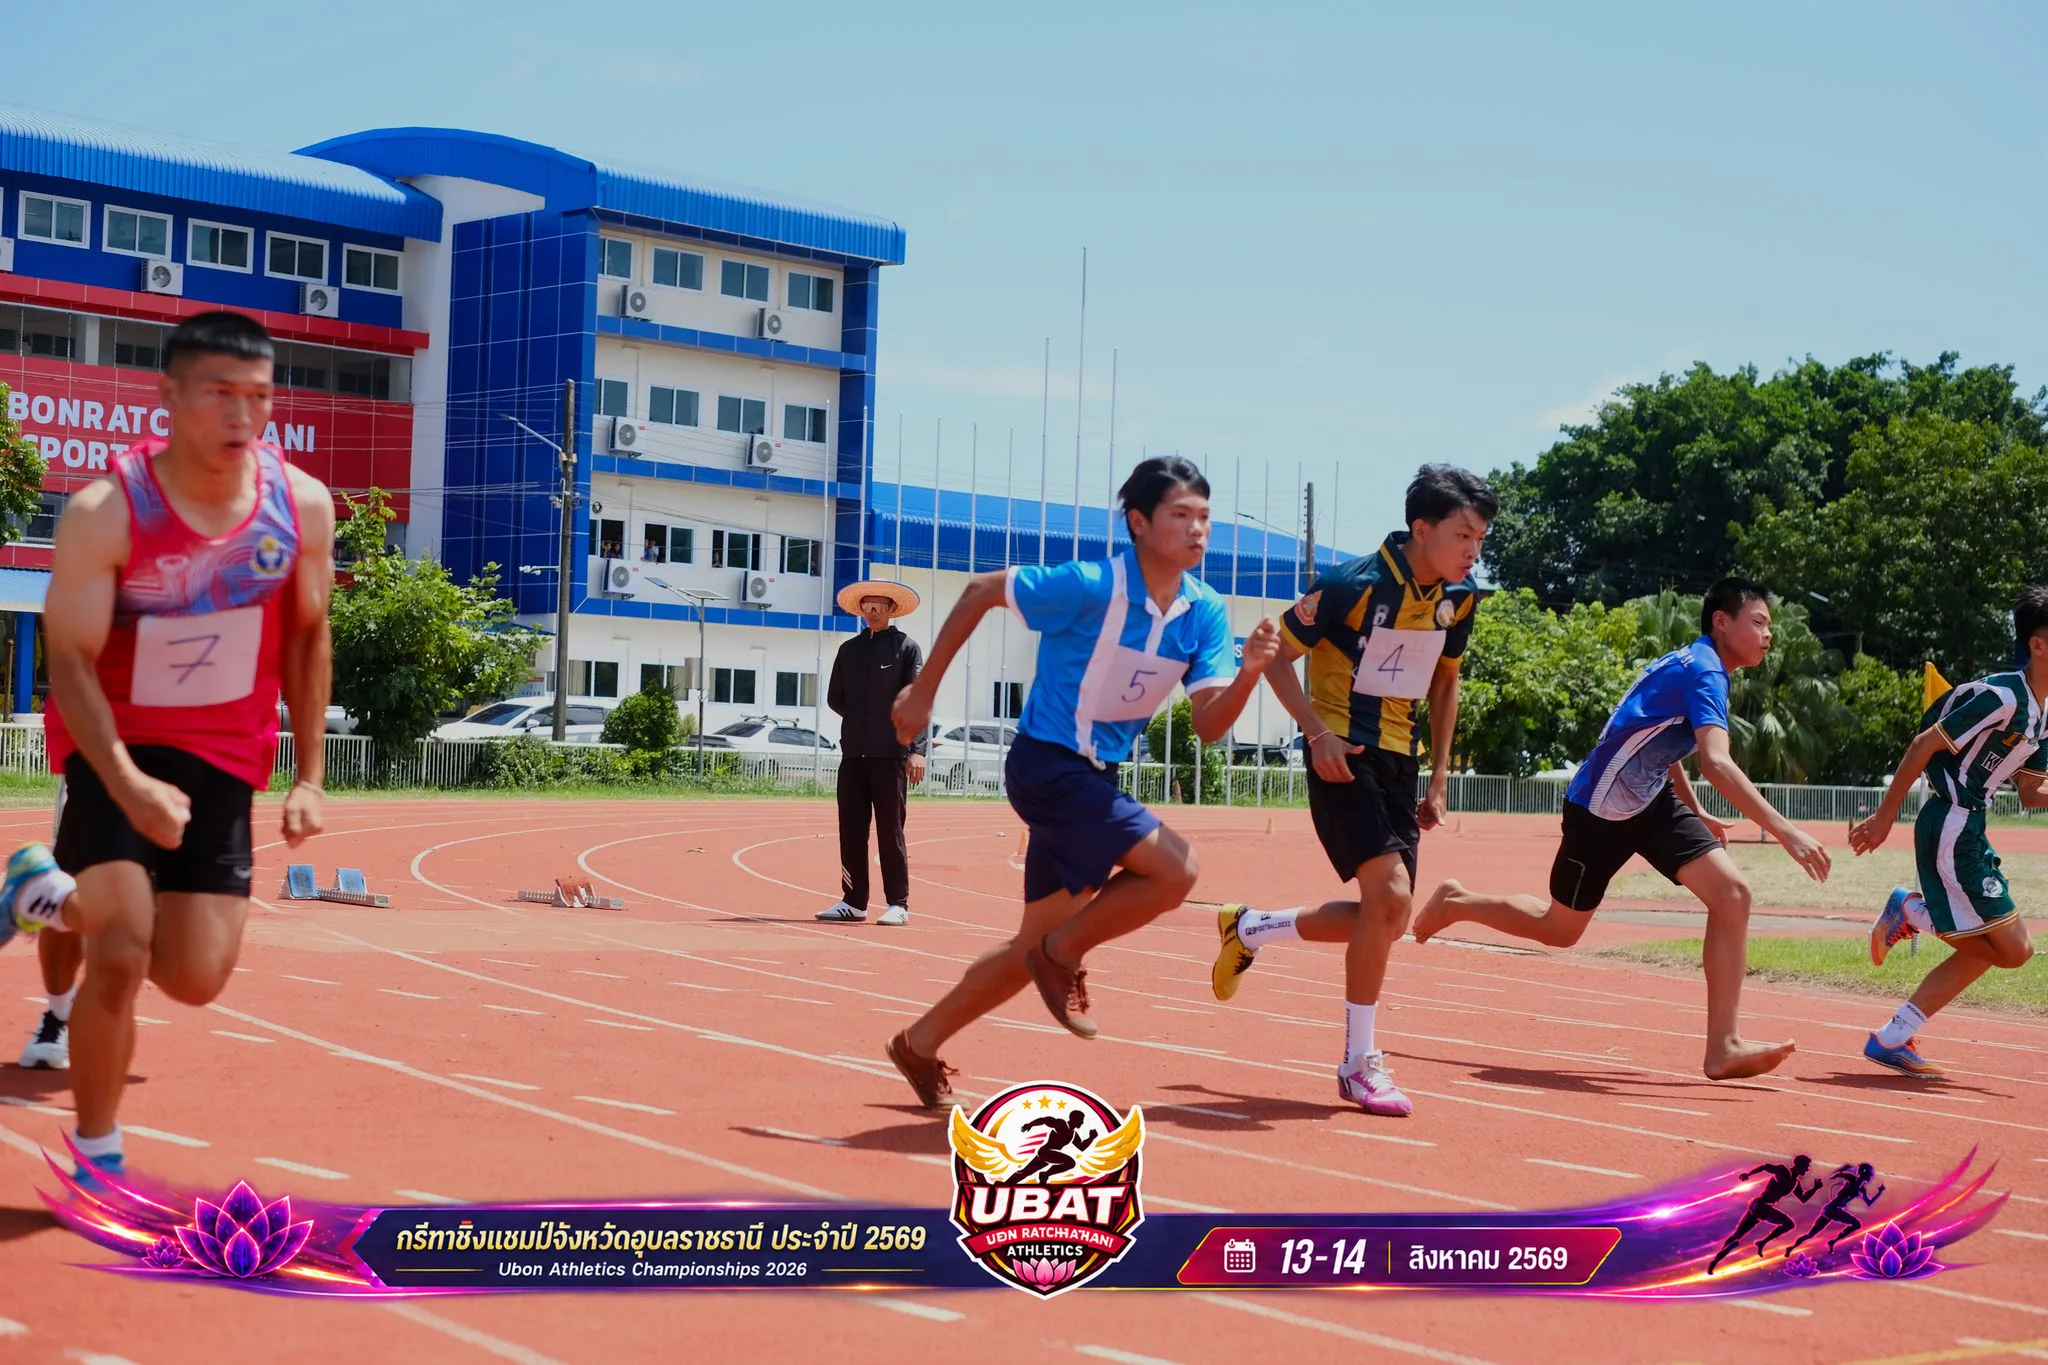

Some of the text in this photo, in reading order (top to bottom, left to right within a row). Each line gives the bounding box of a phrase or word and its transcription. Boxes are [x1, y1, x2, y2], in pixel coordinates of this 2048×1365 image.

[166, 634, 221, 685] 7
[1377, 643, 1404, 683] 4
[1121, 669, 1158, 703] 5
